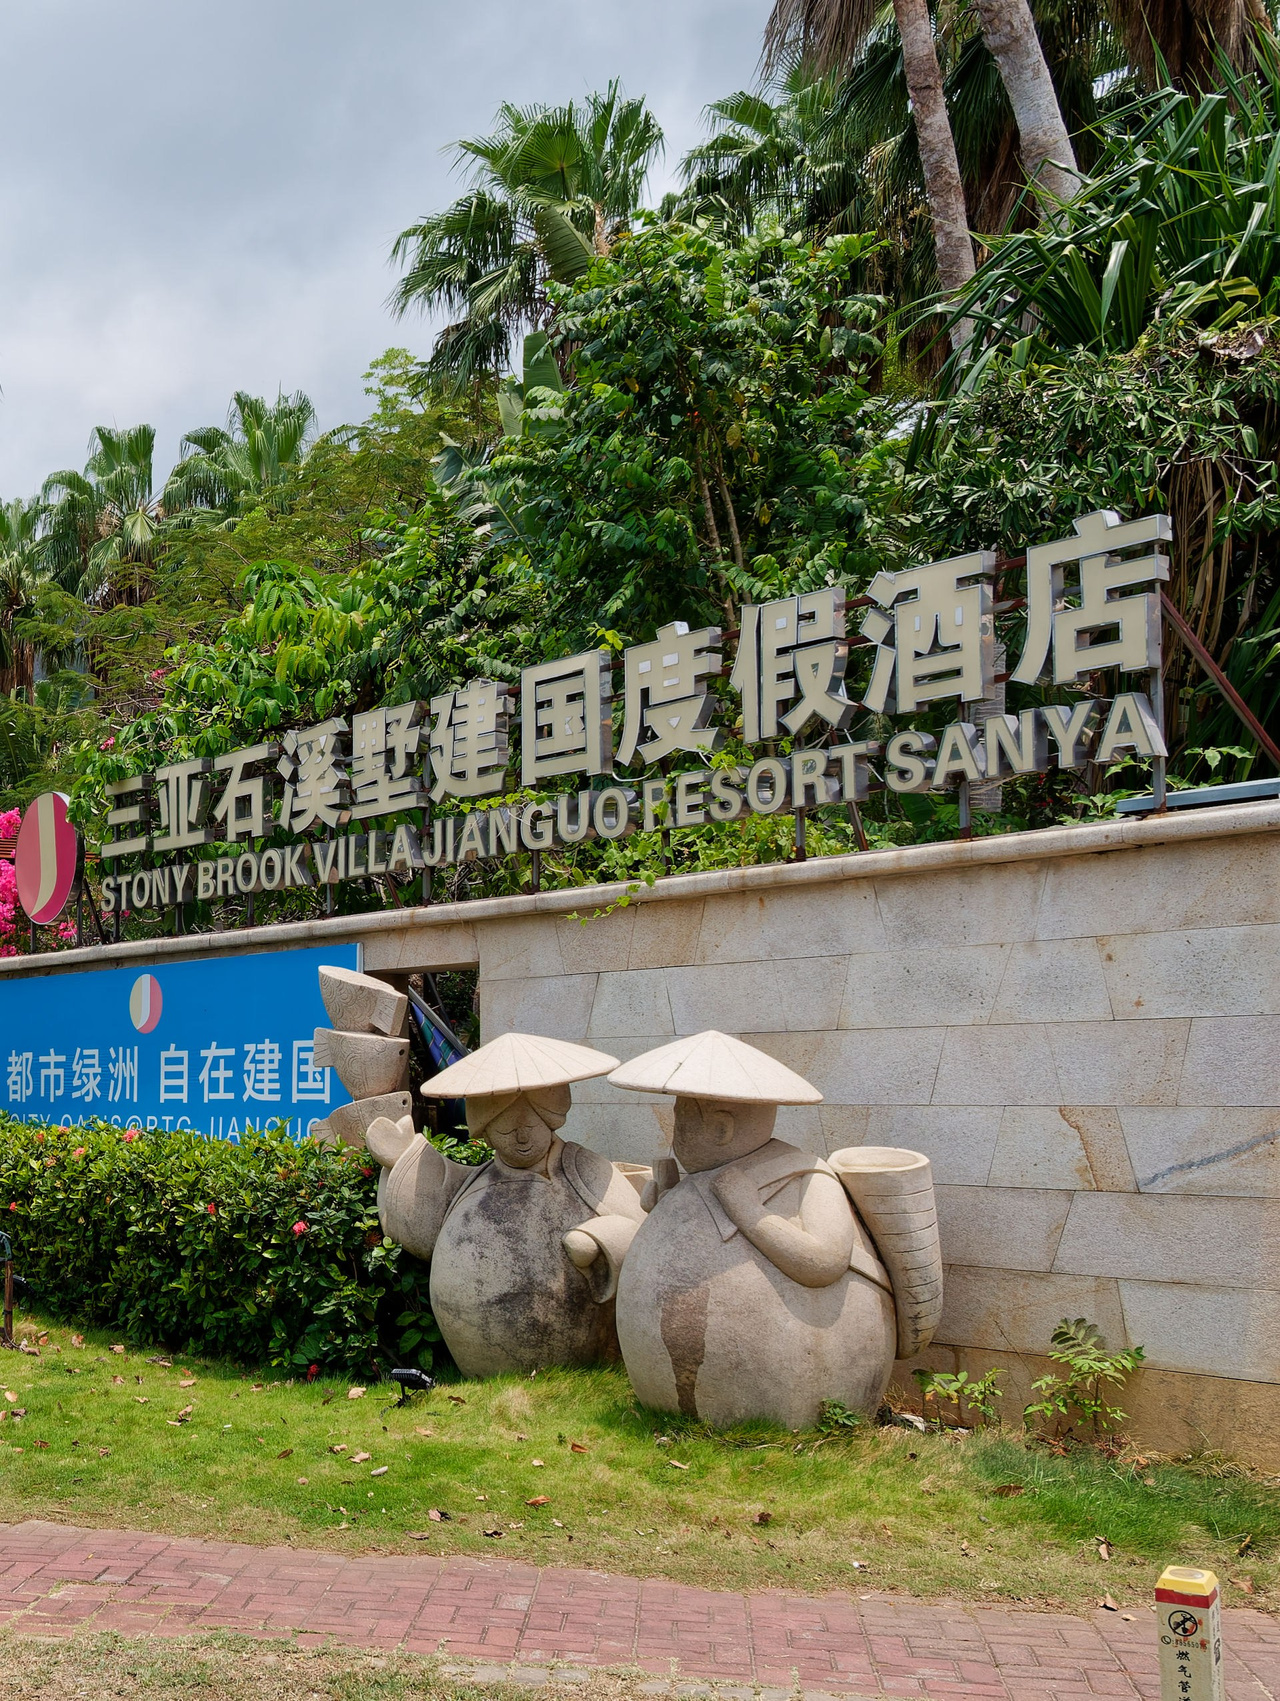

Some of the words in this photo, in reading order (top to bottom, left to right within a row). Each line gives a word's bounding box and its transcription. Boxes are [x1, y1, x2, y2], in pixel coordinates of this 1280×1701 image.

[101, 509, 1172, 858] 三亚石溪墅建国度假酒店
[101, 863, 193, 912] STONY
[197, 844, 311, 900] BROOK
[313, 824, 419, 885] VILLA
[422, 787, 631, 867] JIANGUO
[643, 740, 870, 832] RESORT
[884, 692, 1168, 794] SANYA
[6, 1046, 139, 1103] 都市绿洲
[159, 1038, 331, 1104] 自在建国
[1176, 1650, 1192, 1701] 燃气管
